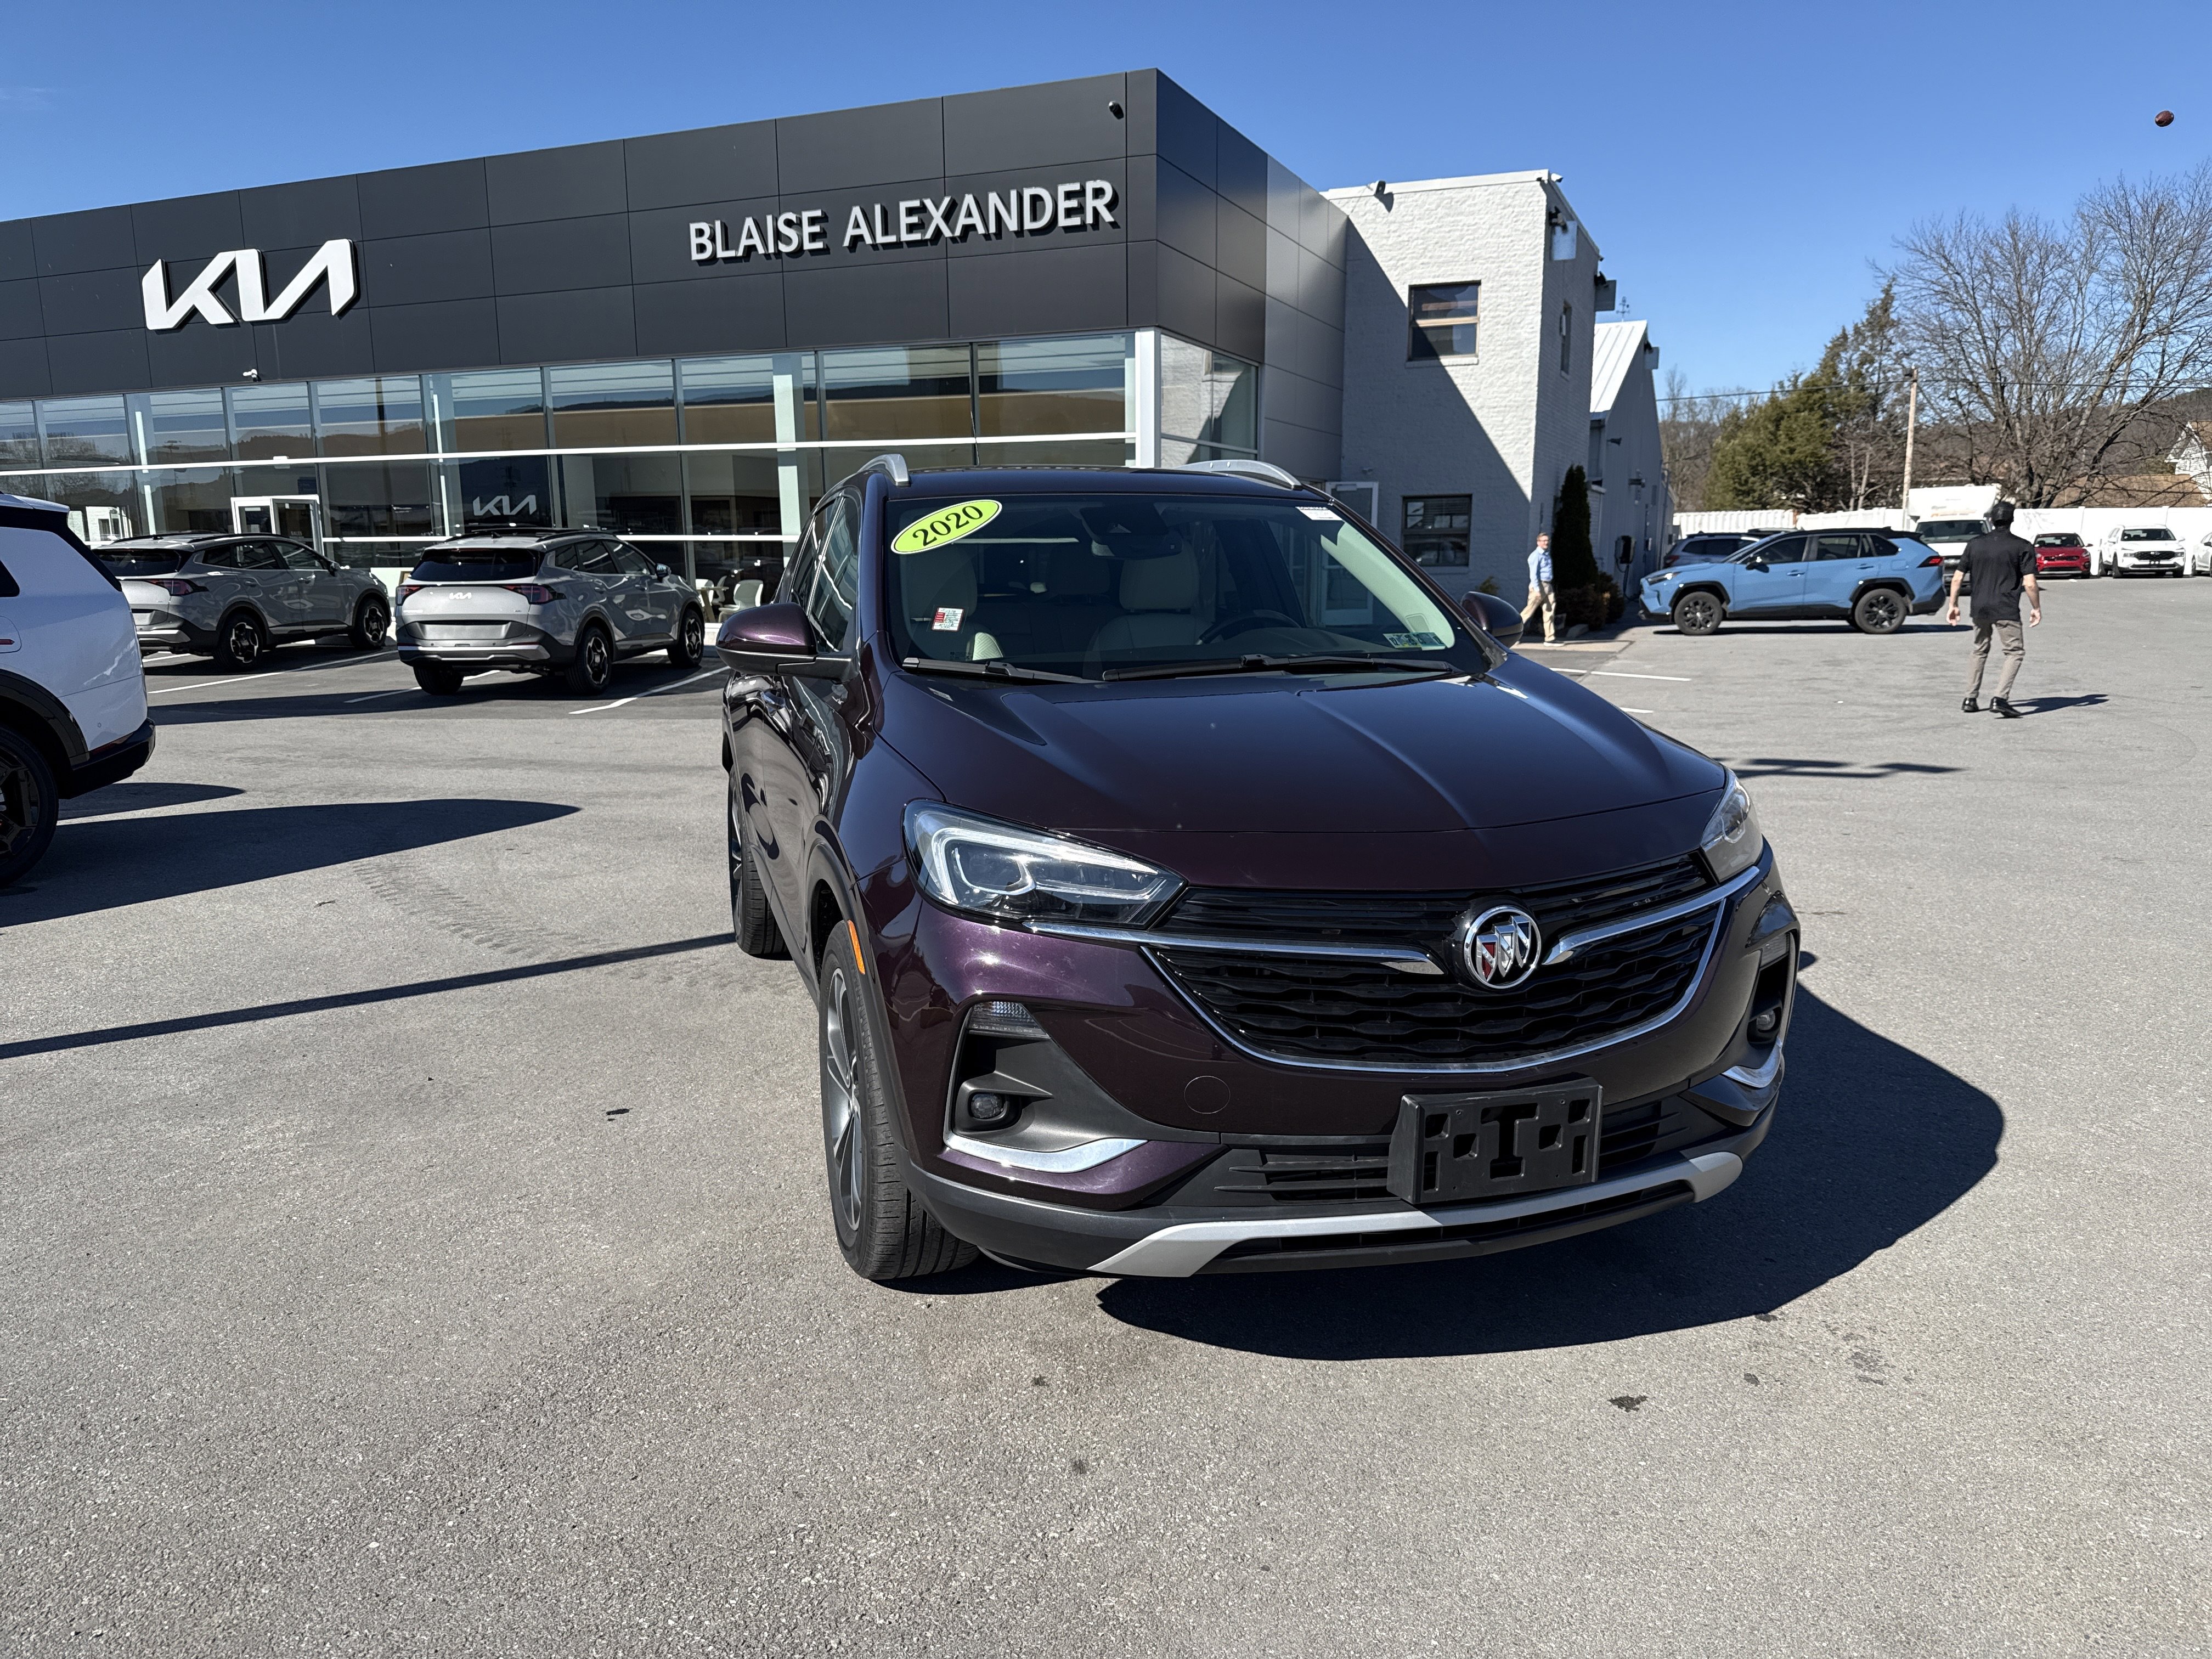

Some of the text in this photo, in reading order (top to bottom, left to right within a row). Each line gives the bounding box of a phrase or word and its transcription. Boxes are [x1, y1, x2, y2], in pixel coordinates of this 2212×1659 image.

[689, 179, 1116, 261] BLAISE ALEXANDER
[142, 238, 356, 330] KIA
[472, 494, 537, 516] KIA
[912, 505, 983, 546] 2020
